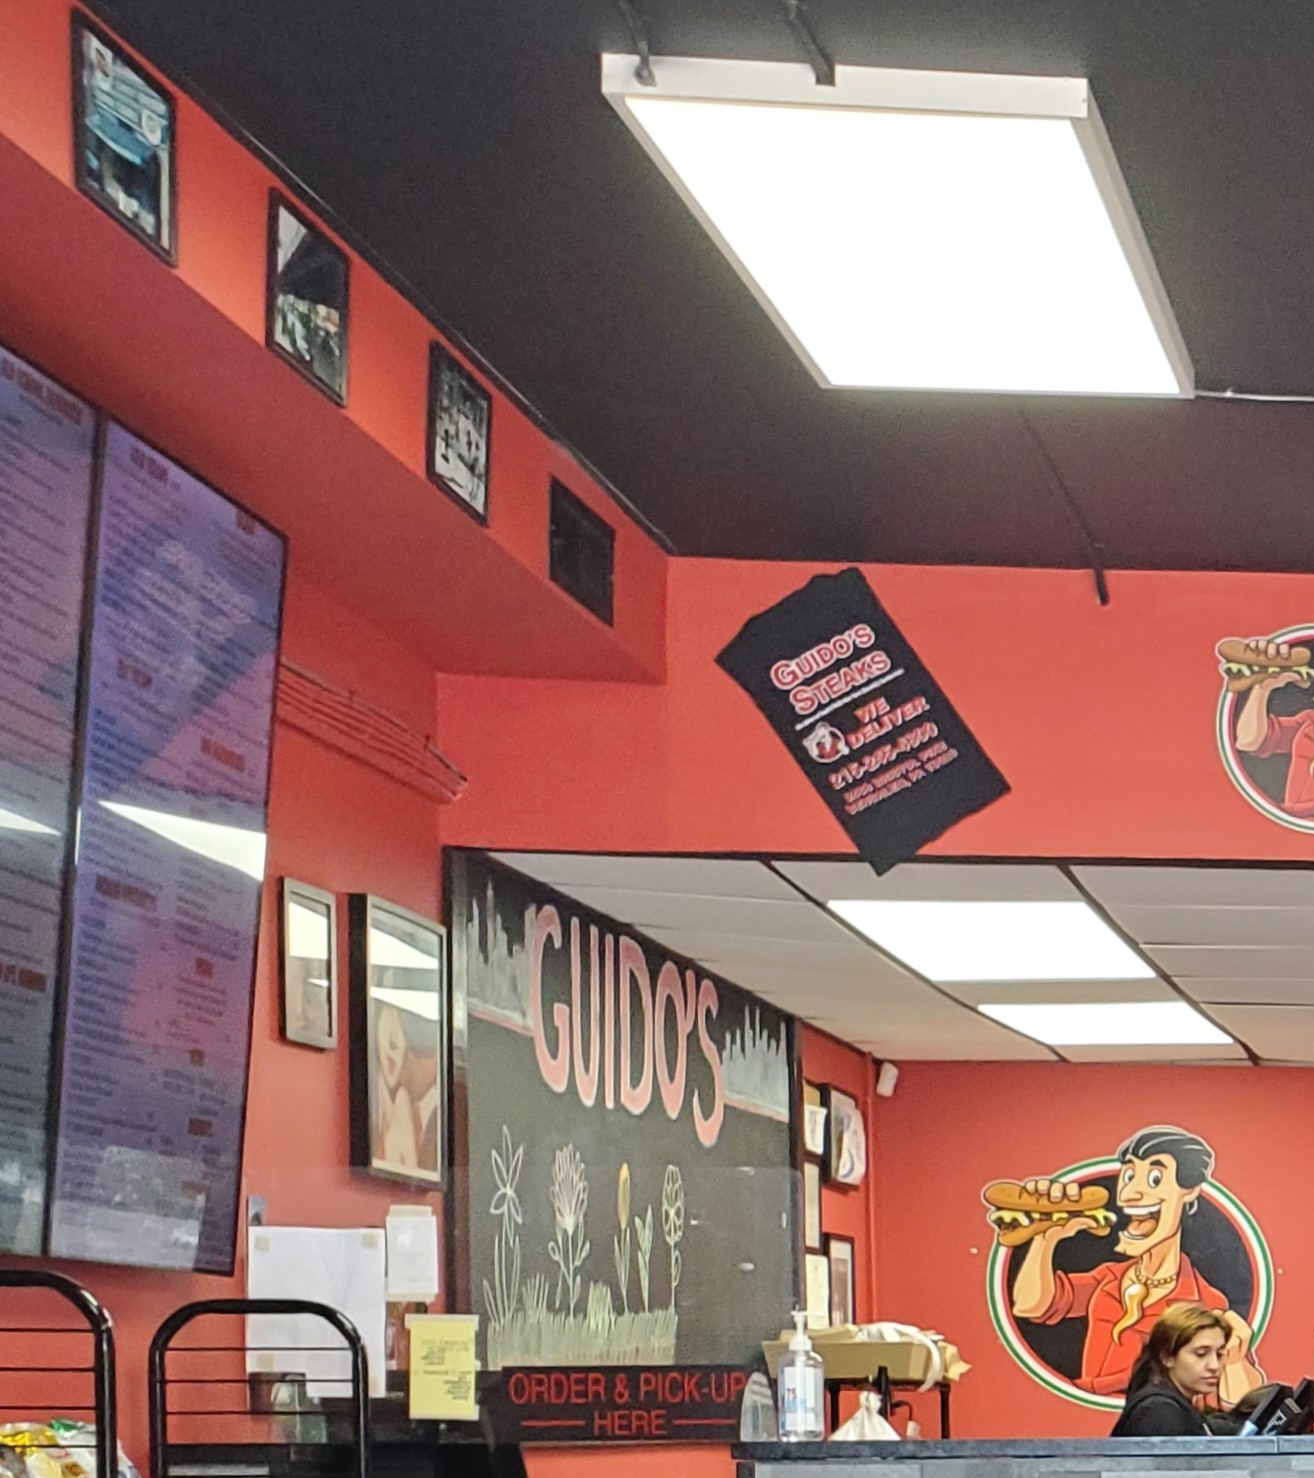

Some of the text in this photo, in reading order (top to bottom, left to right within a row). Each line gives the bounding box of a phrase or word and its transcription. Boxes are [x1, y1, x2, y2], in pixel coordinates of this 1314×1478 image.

[770, 623, 875, 690] GUIDO'S
[789, 650, 891, 714] STEAKS
[846, 696, 931, 750] DELIVER
[853, 696, 890, 723] WE
[532, 904, 724, 1148] GUIDO'S
[508, 1372, 747, 1404] ORDER & PICK-UP
[593, 1410, 668, 1436] HERE
